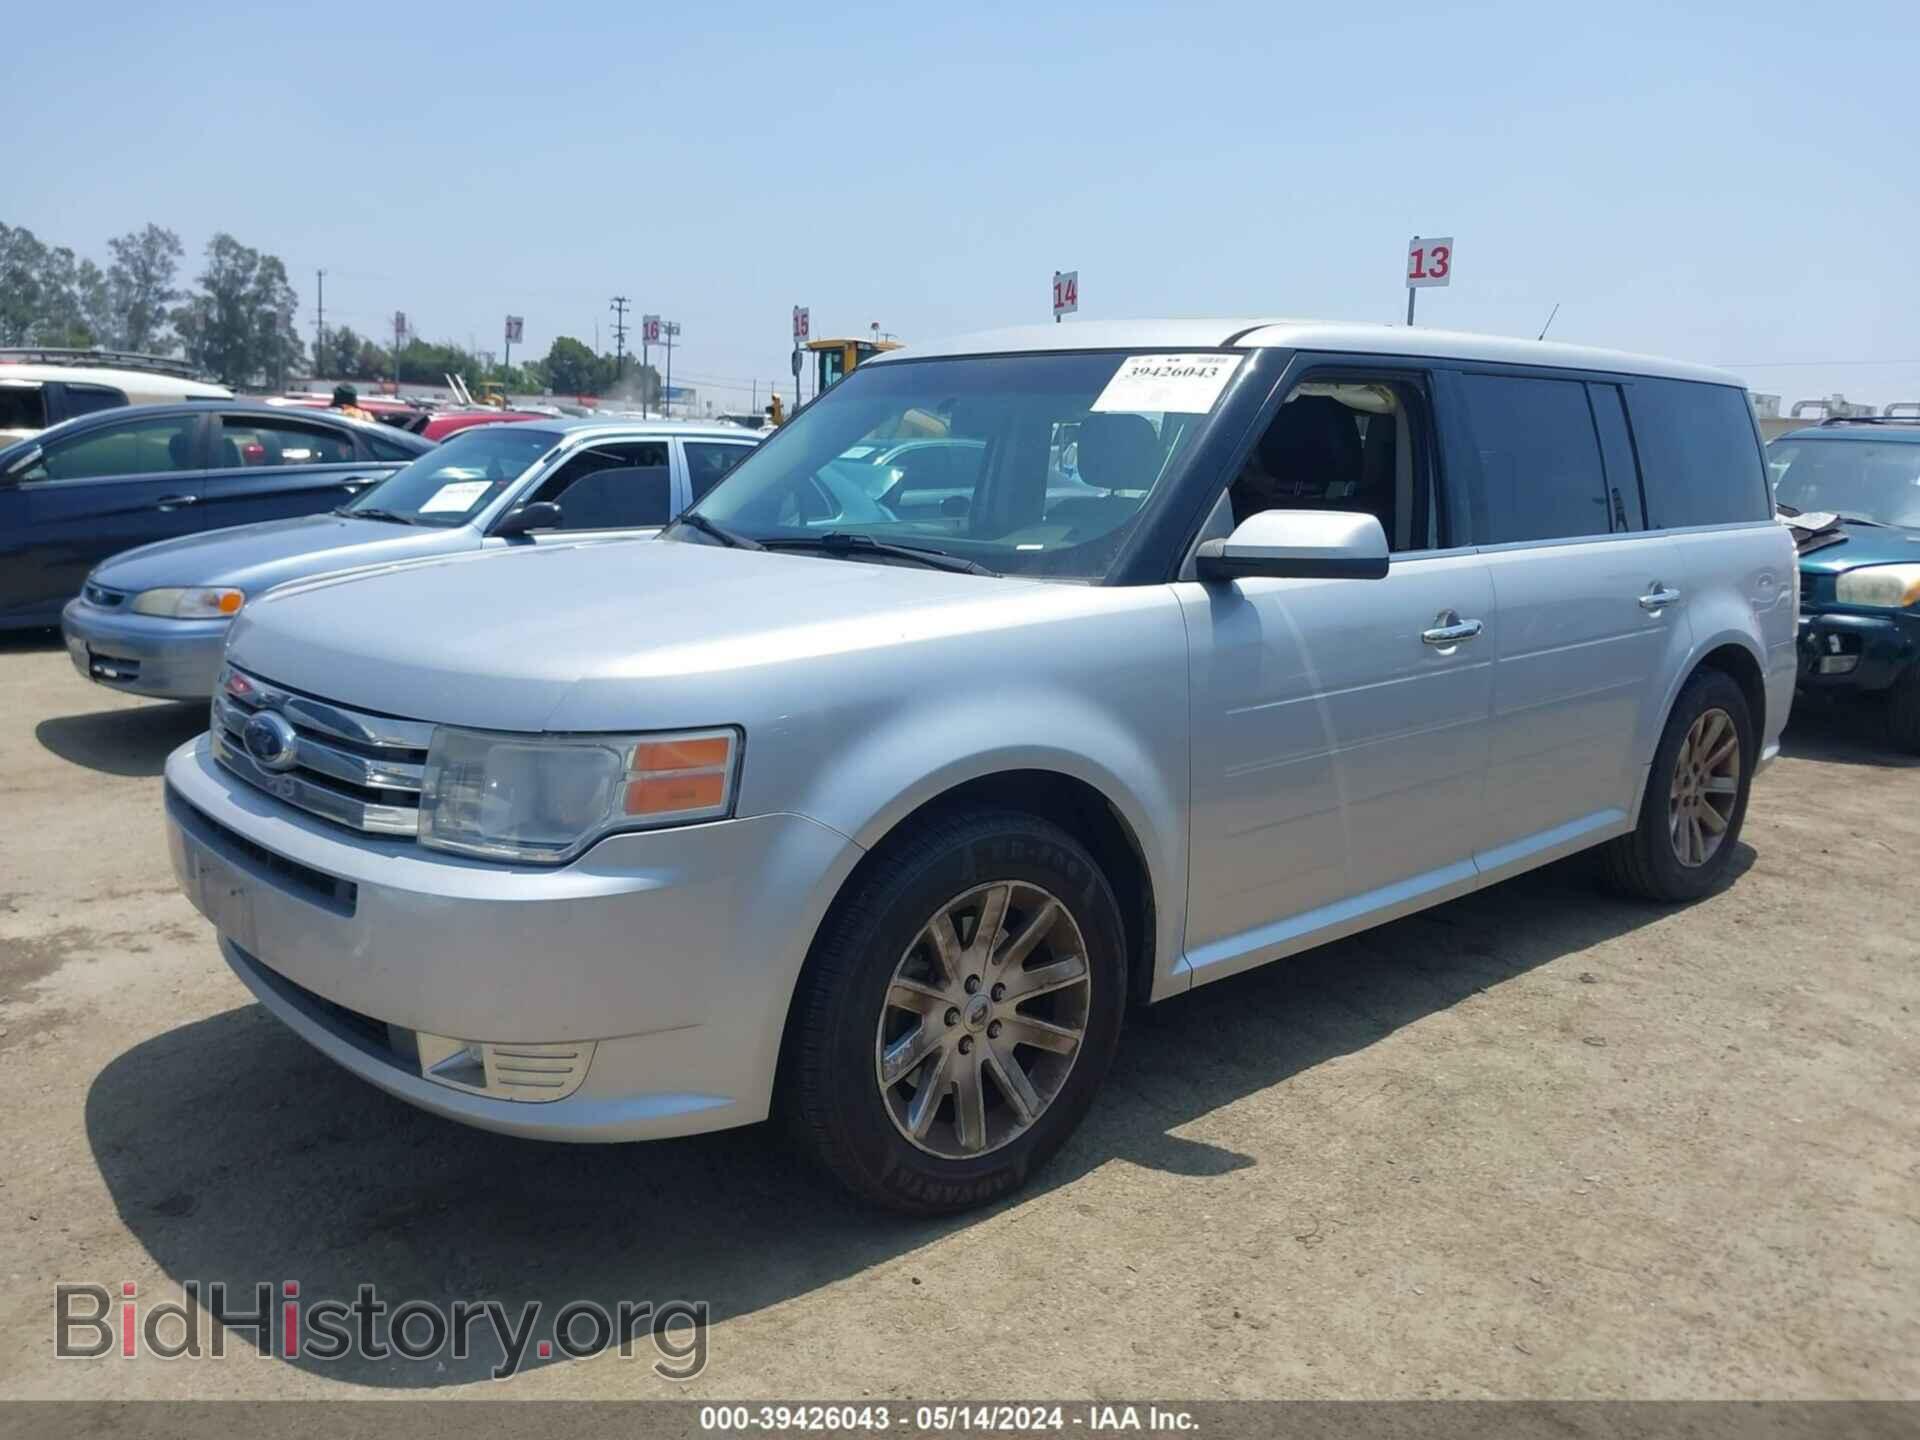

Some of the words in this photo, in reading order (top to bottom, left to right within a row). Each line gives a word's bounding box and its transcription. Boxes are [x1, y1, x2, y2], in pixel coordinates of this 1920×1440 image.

[1409, 246, 1449, 279] 13
[1054, 279, 1077, 309] 14
[506, 321, 523, 339] 17
[643, 320, 660, 341] 16
[793, 313, 809, 337] 15
[1131, 366, 1218, 378] 39426043
